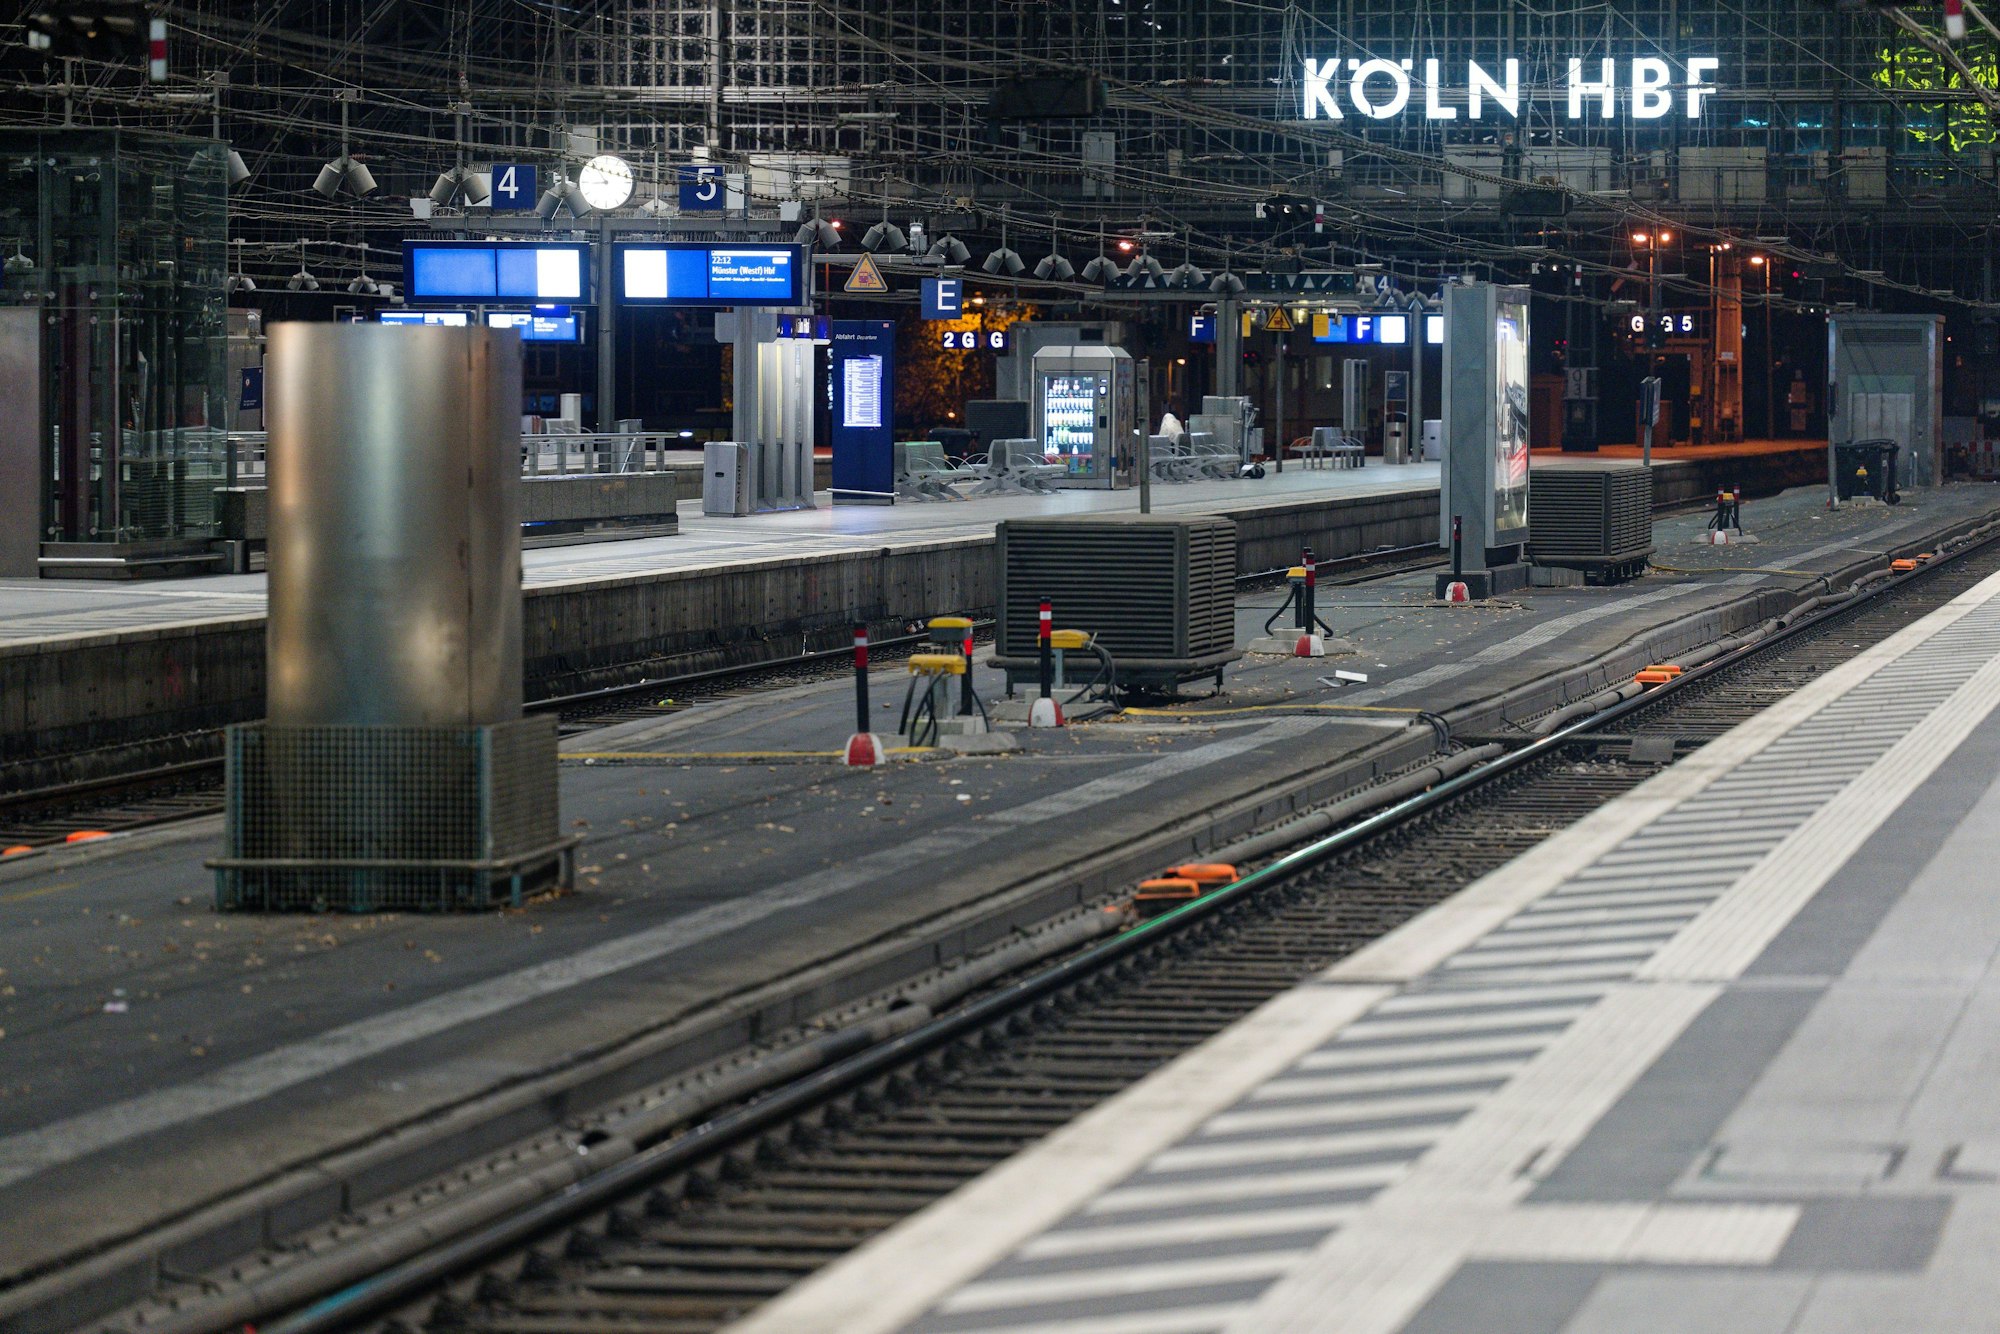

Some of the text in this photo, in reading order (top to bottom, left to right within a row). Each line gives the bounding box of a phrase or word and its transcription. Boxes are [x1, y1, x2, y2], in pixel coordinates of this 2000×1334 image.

[1302, 57, 1719, 120] KÖLN HBF
[498, 166, 519, 199] 4
[695, 167, 717, 201] 5
[711, 266, 738, 275] Münster
[763, 266, 776, 275] Hbf
[1378, 275, 1389, 290] 4
[937, 280, 957, 311] E
[1191, 316, 1204, 337] F
[1356, 316, 1372, 340] F
[1631, 315, 1645, 332] G
[1681, 315, 1693, 332] 5
[835, 333, 856, 341] Abfahrt
[943, 331, 1004, 349] 2 G G
